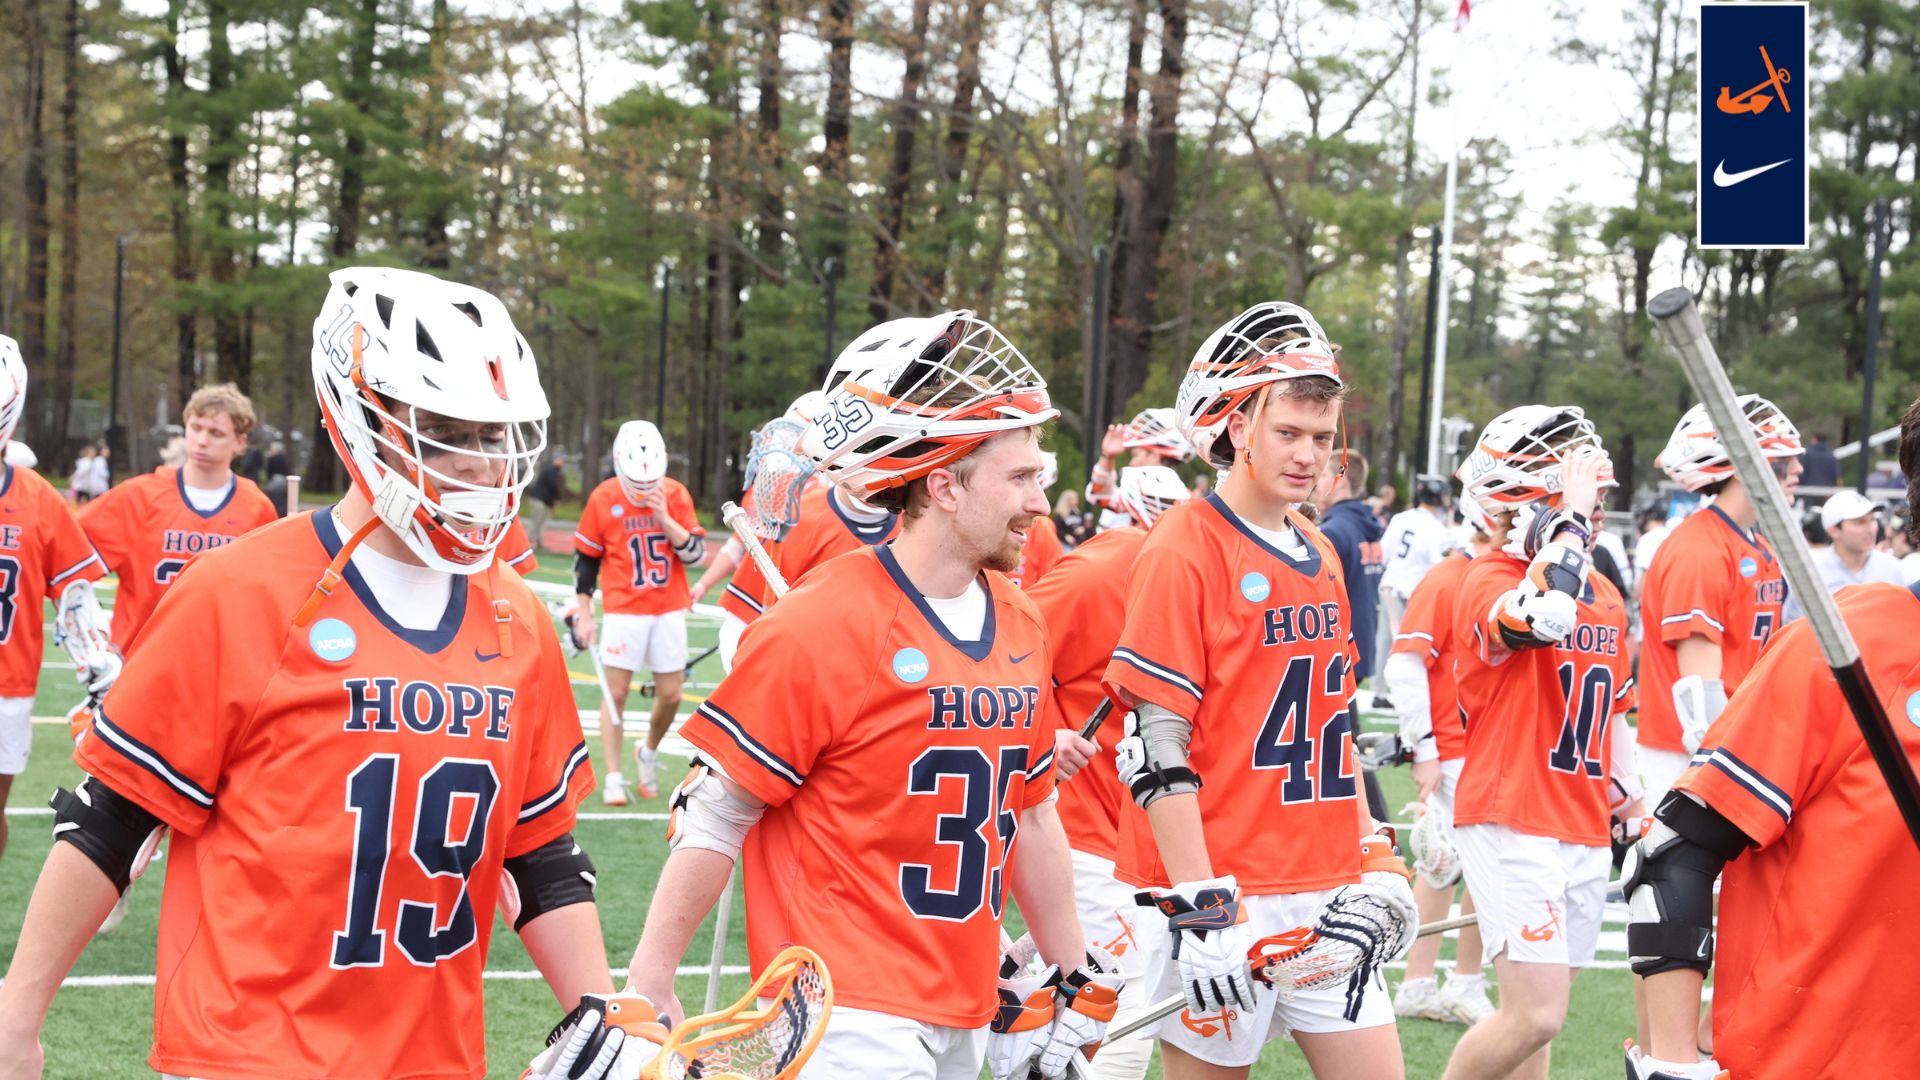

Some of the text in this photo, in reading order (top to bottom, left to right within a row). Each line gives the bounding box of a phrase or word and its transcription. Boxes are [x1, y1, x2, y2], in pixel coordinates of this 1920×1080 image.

[320, 304, 371, 378] 19
[813, 390, 873, 450] 35
[628, 532, 672, 589] 15
[1398, 530, 1415, 559] 5
[317, 637, 355, 651] NCAA
[1263, 601, 1341, 647] HOP
[898, 661, 929, 676] NCAA
[342, 676, 516, 743] HOPE
[1251, 652, 1358, 805] 42
[1548, 660, 1613, 780] 10
[328, 752, 502, 971] 19
[898, 744, 1031, 924] 35
